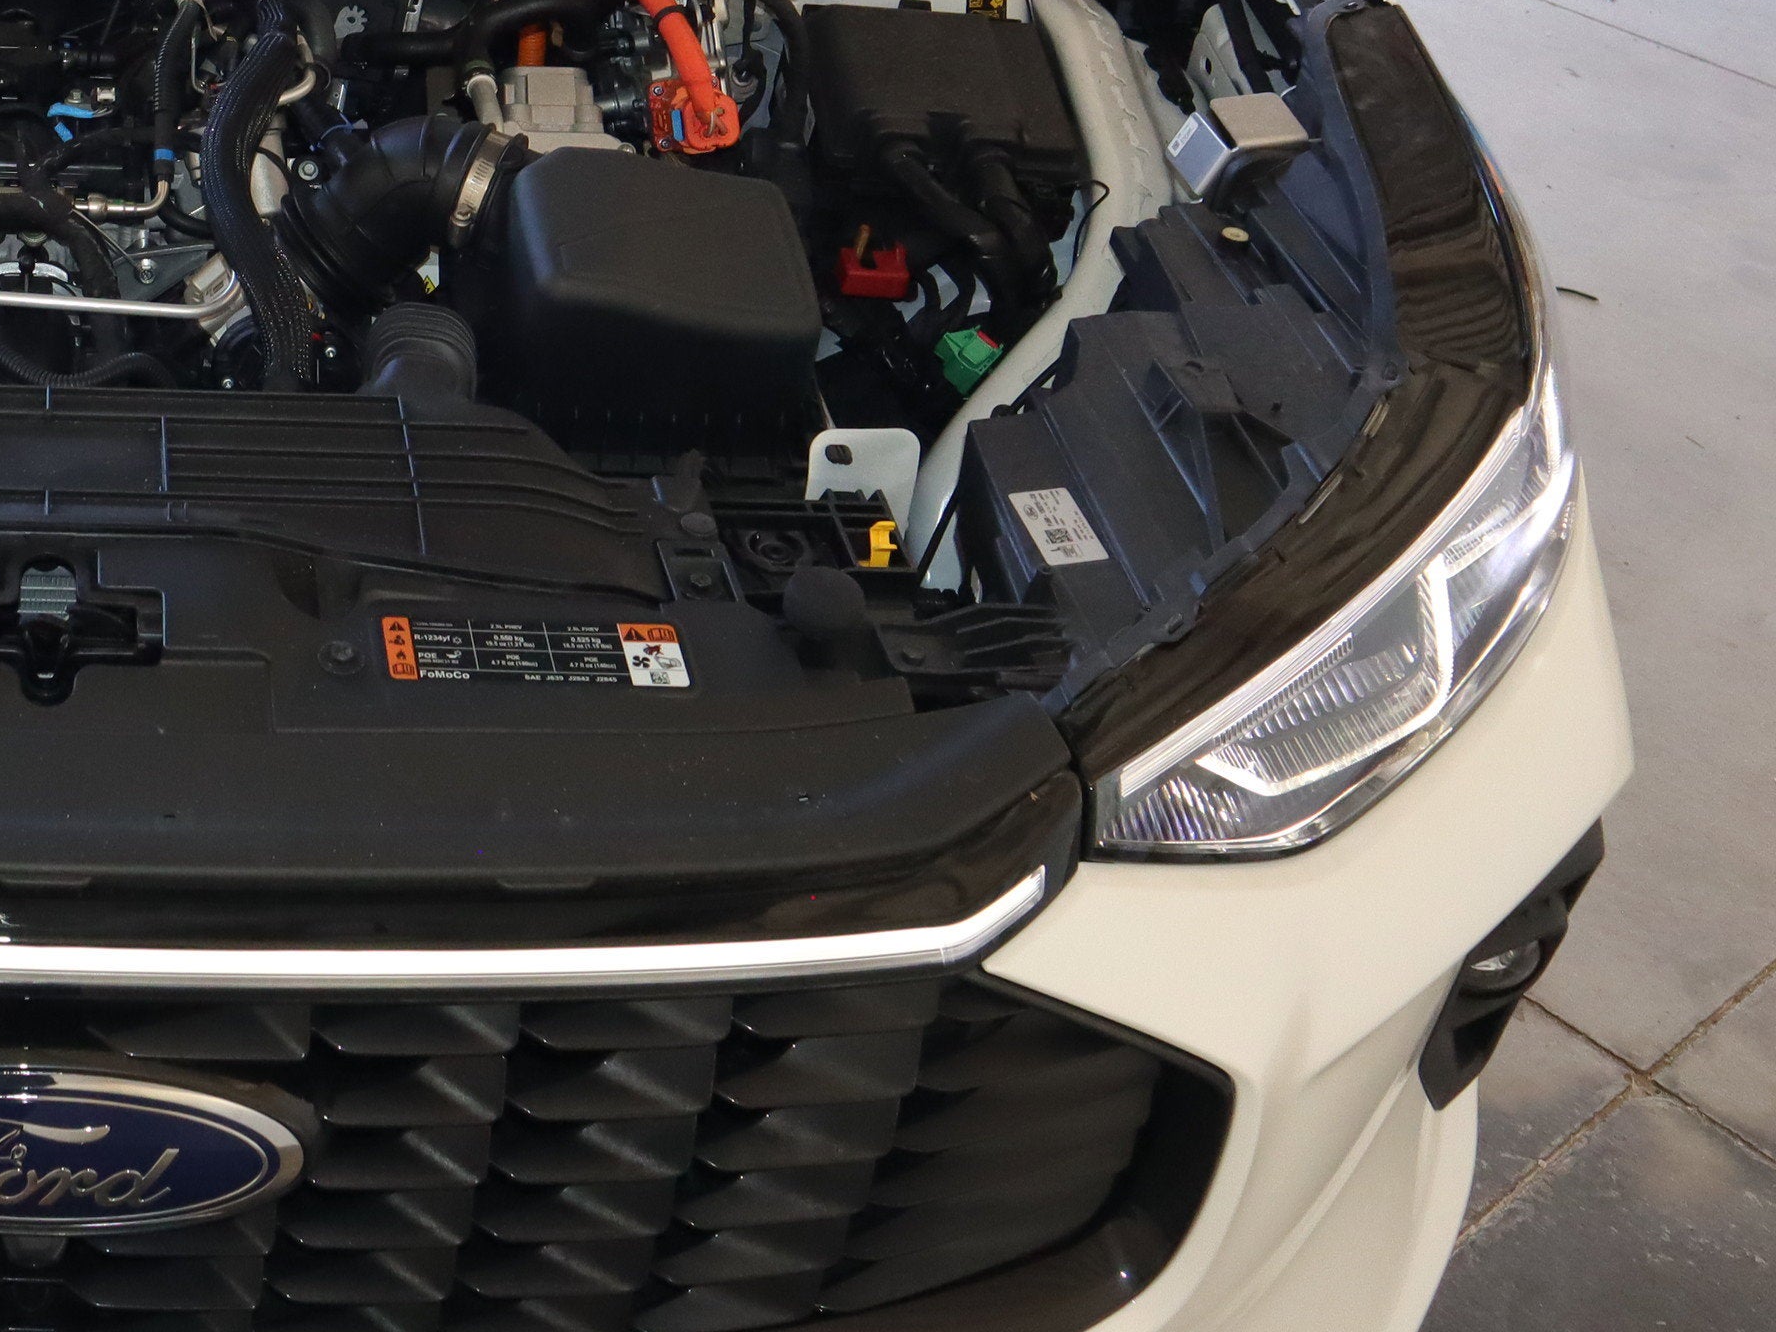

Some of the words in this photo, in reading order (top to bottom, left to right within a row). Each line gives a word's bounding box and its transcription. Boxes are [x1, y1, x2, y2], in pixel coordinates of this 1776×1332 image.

[414, 633, 451, 643] R-1234yf
[419, 670, 470, 680] FoMoCo
[525, 674, 542, 682] SAE
